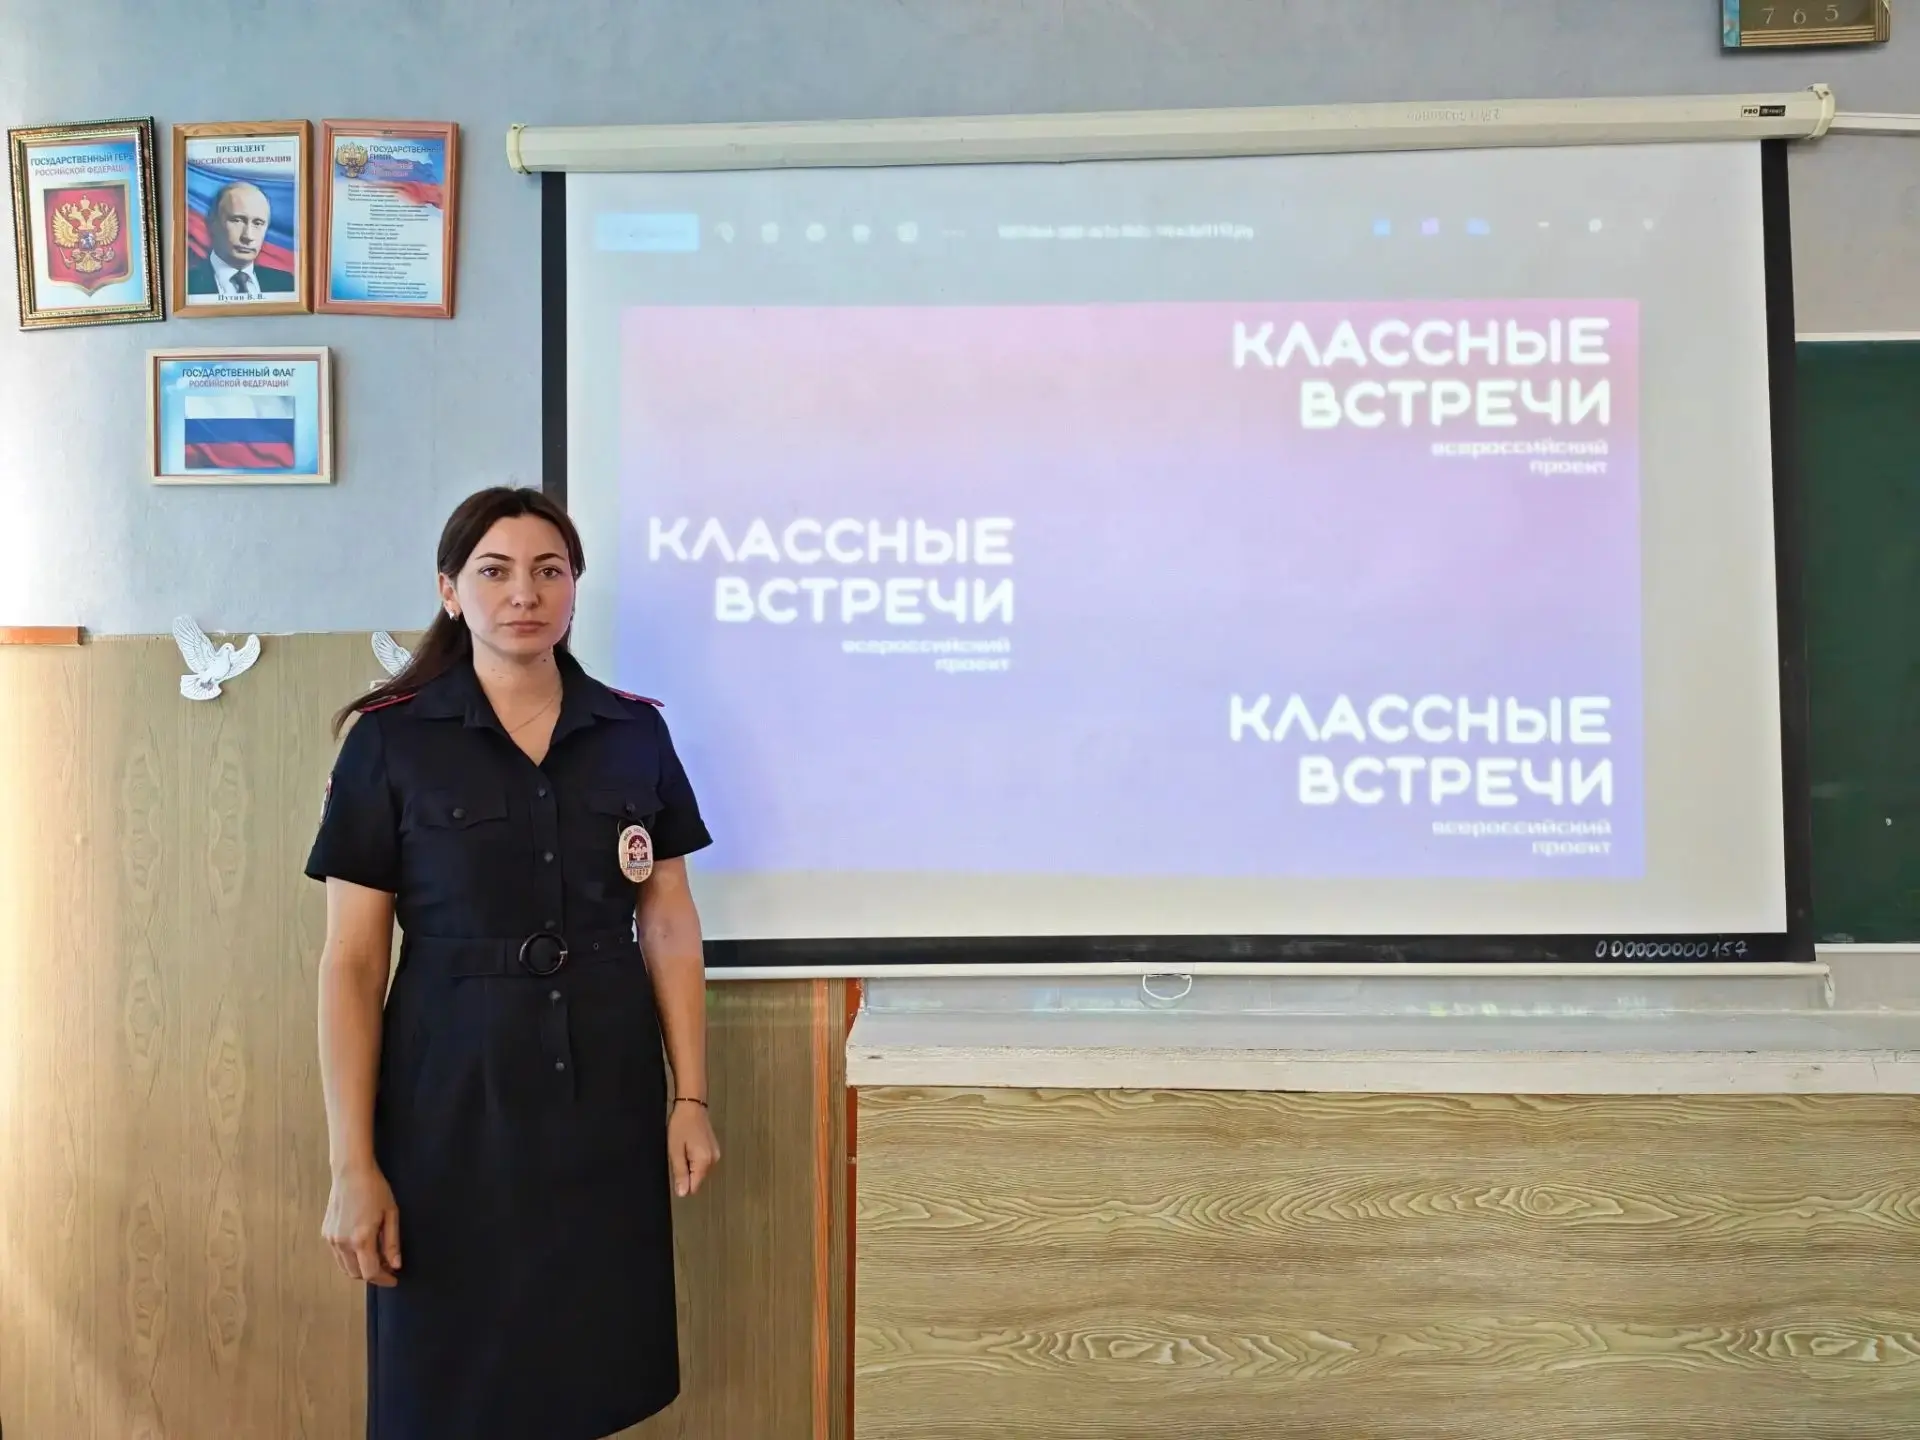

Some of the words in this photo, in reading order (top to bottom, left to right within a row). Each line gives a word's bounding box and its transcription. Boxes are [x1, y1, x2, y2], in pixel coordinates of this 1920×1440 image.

[1761, 8, 1776, 25] 7
[1792, 8, 1807, 24] 6
[1824, 4, 1840, 22] 5
[215, 144, 266, 154] ПРЕЗИДЕНТ
[30, 151, 113, 167] ГОСУДАРСТВЕННЫЙ
[87, 163, 128, 175] ФЕДЕРАЦИ
[217, 292, 245, 304] Путин
[1232, 317, 1611, 368] КЛАССНЫЕ
[182, 367, 270, 379] ГОСУДАРСТВЕННЫЙ
[272, 367, 297, 378] ФЛАГ
[188, 379, 241, 389] РОССИЙСКОЙ
[242, 379, 289, 388] ФЕДЕРАЦИИ
[1300, 378, 1611, 429] ВСТРЕЧИ
[1529, 459, 1608, 477] проект
[648, 516, 1015, 565] КЛАССНЫЕ
[714, 576, 1014, 625] ВСТРЕЧИ
[1229, 693, 1612, 744] КЛАССНЫЕ
[1298, 755, 1613, 807] ВСТРЕЧИ
